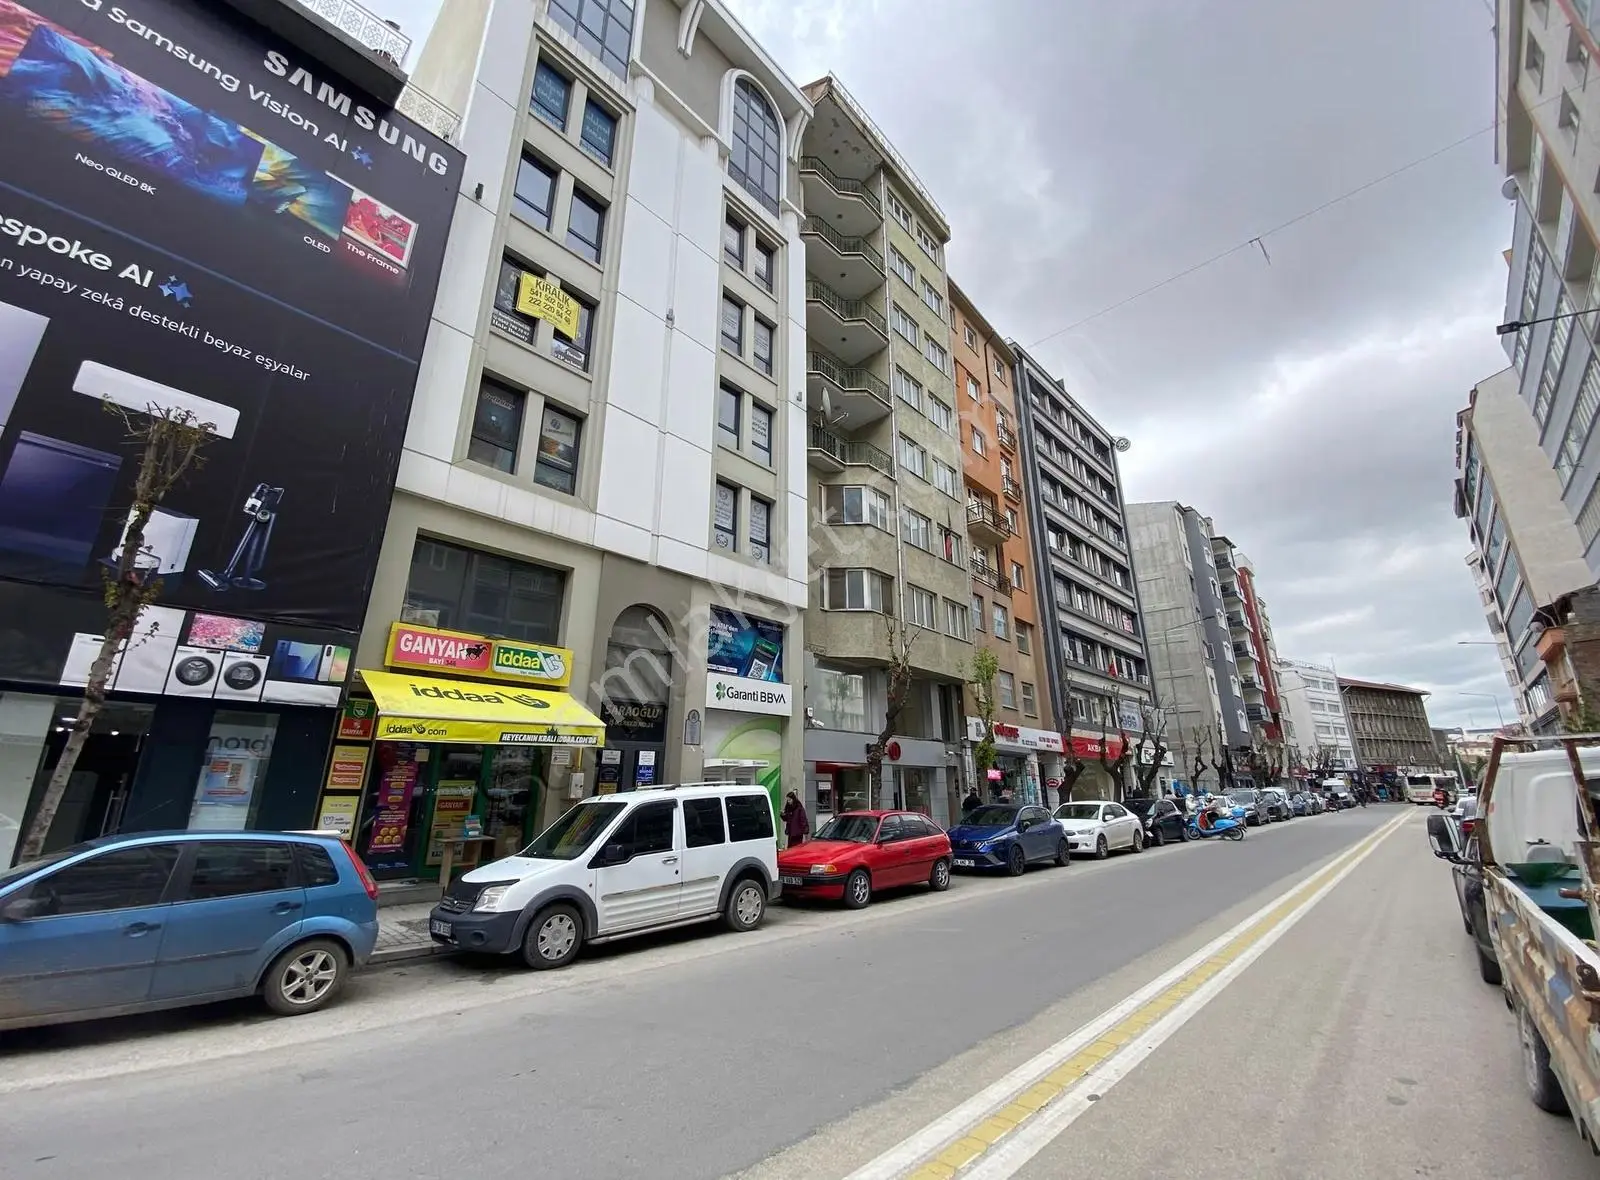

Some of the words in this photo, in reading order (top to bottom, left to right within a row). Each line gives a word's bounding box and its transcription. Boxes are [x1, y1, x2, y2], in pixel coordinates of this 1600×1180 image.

[248, 83, 320, 137] Vision
[323, 132, 348, 152] AI
[263, 50, 449, 176] SAMSUNG
[75, 152, 104, 171] Neo
[105, 167, 139, 187] QLED
[139, 183, 157, 196] 8K
[303, 235, 331, 254] OLED
[346, 242, 366, 258] The
[367, 253, 400, 275] Frame
[118, 263, 154, 288] AI
[528, 296, 542, 307] 222
[16, 264, 78, 294] yapay
[80, 287, 125, 311] zekâ
[129, 304, 200, 339] destekli
[203, 331, 252, 360] beyaz
[255, 352, 311, 381] eşyalar
[400, 633, 469, 661] GANYAN
[498, 649, 541, 669] iddaa
[409, 683, 504, 705] iddaa
[726, 686, 758, 702] Garanti
[760, 692, 786, 705] BBVA
